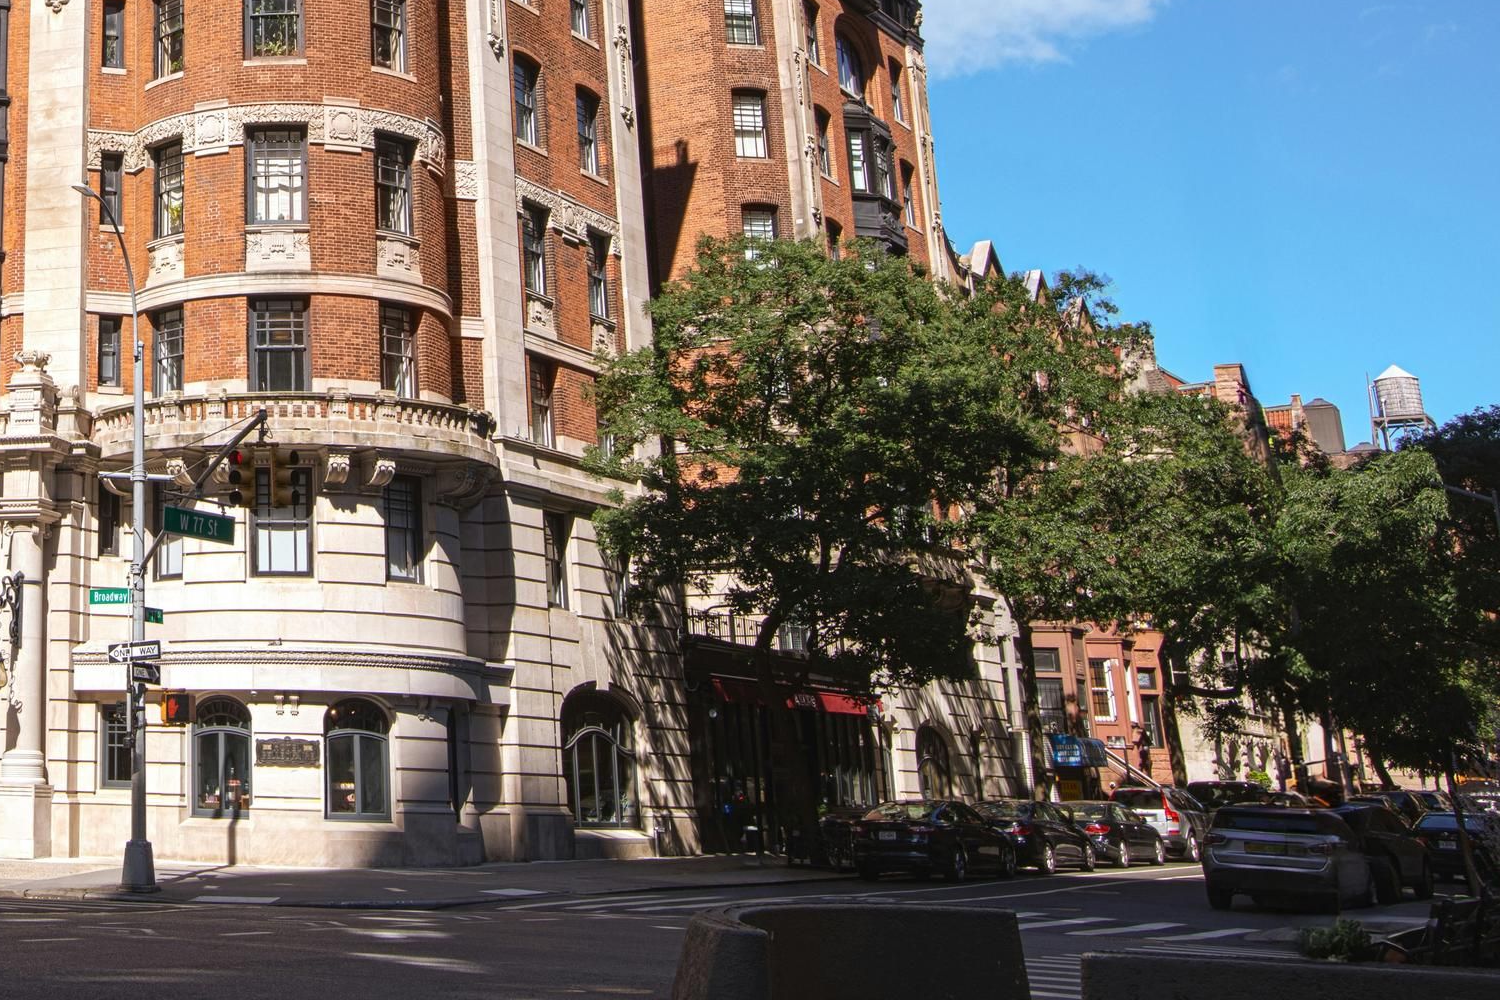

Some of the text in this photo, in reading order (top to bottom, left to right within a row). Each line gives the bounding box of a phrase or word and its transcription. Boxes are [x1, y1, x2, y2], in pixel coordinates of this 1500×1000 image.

[180, 513, 219, 536] W 77 St
[93, 591, 128, 604] Broadway
[113, 646, 156, 658] ONE WAY
